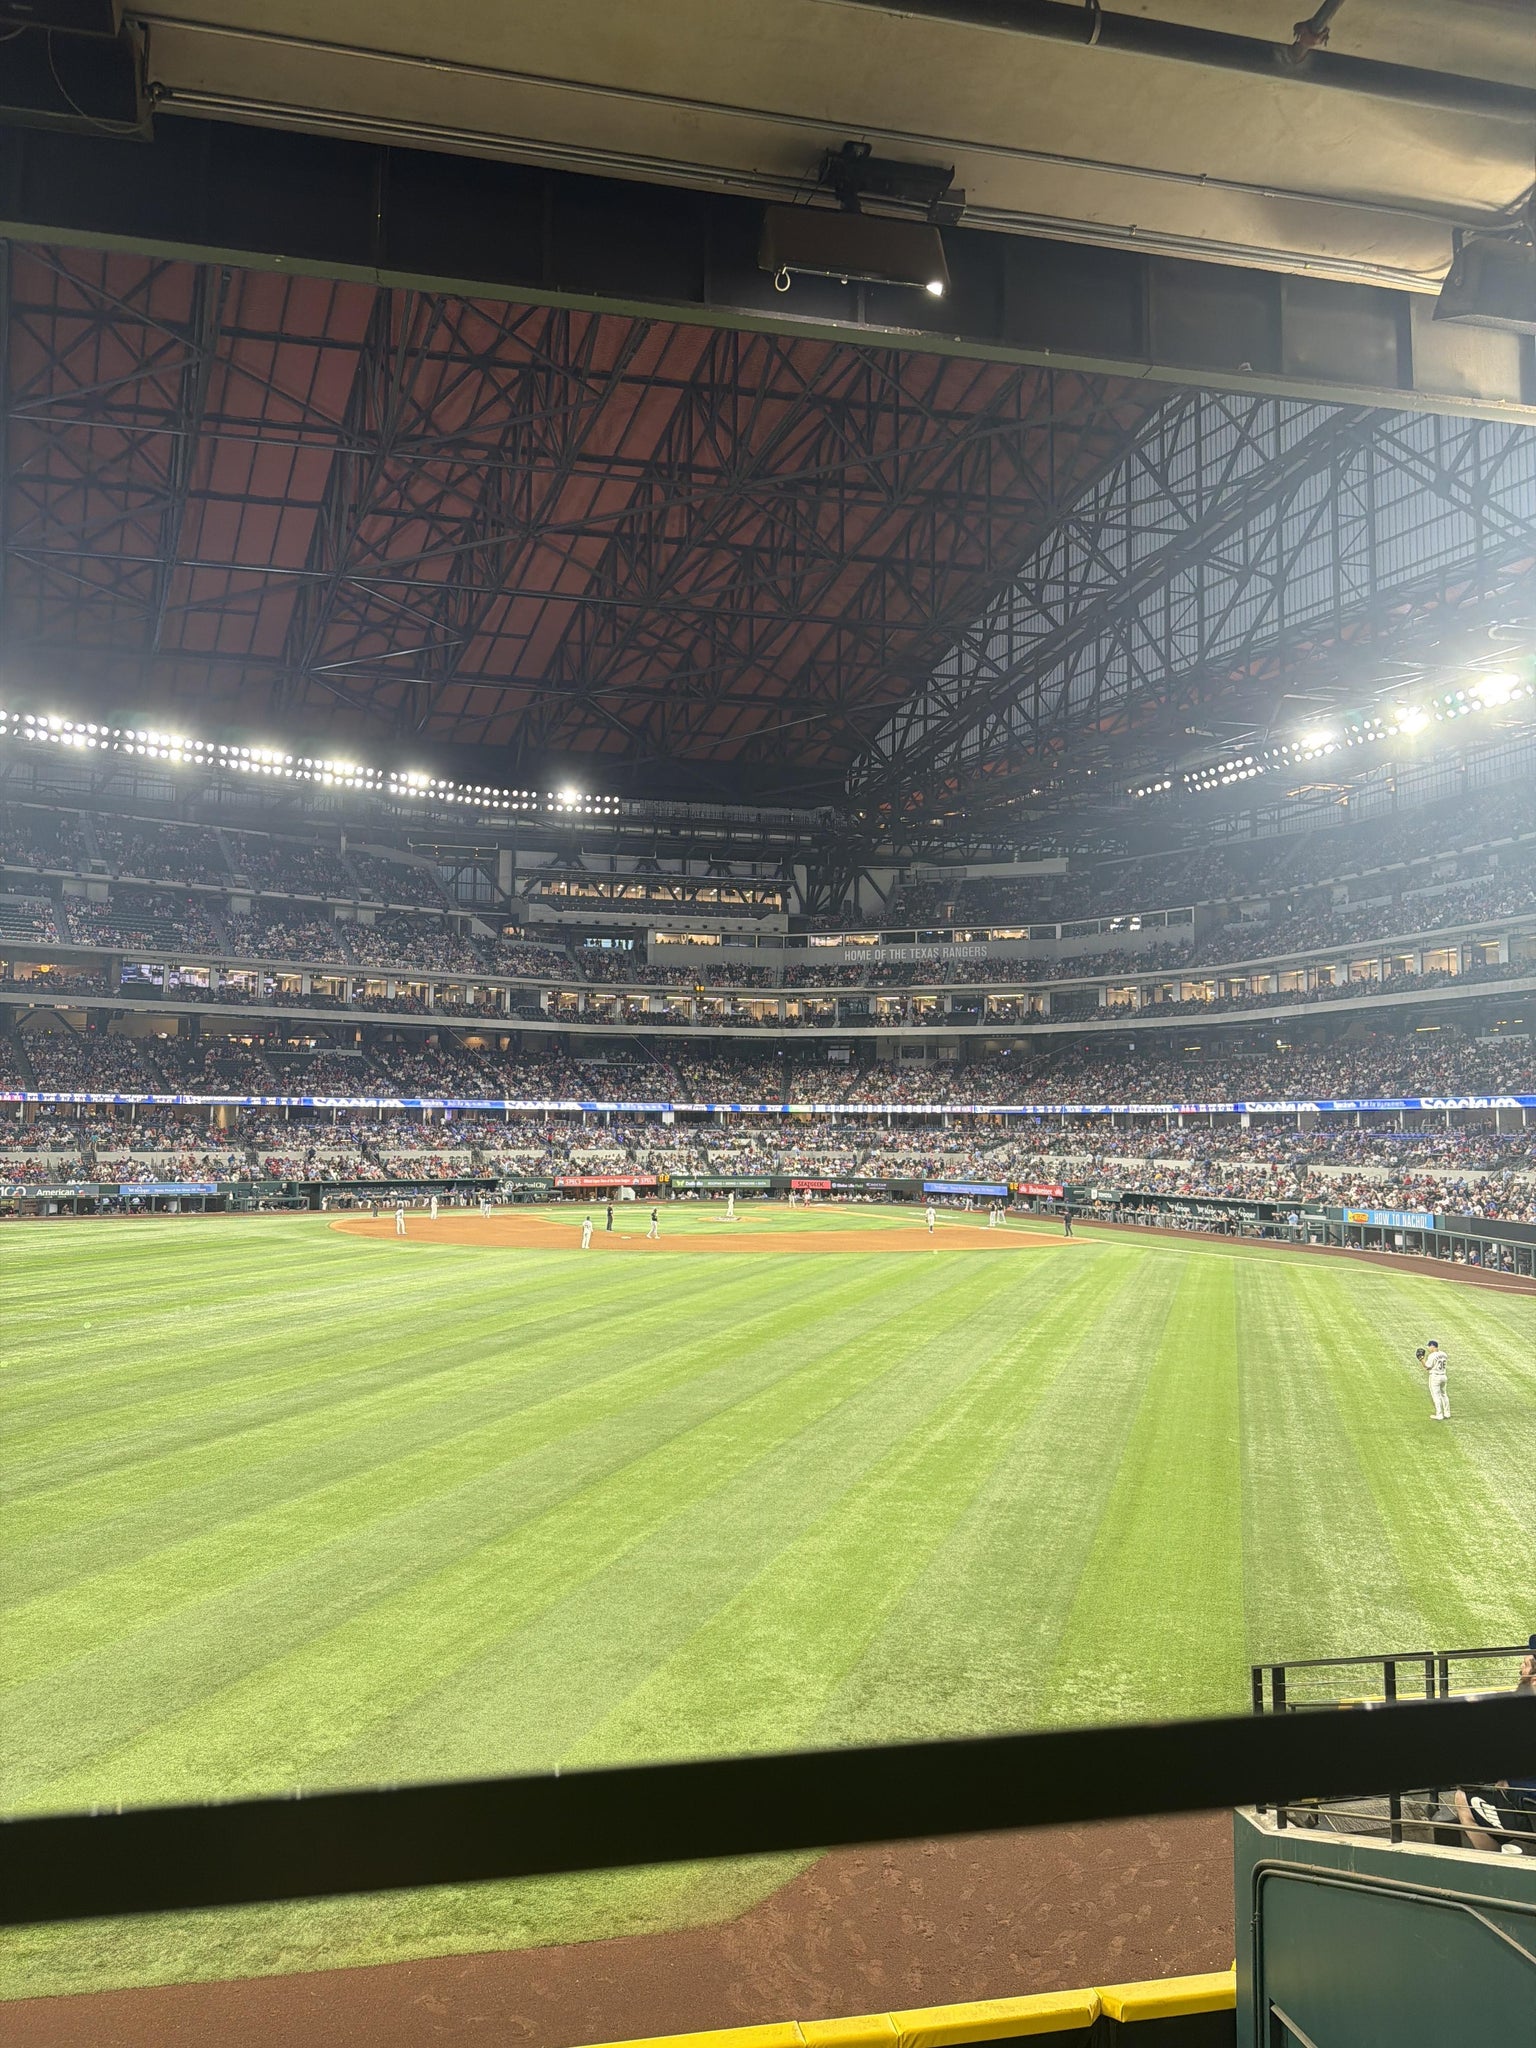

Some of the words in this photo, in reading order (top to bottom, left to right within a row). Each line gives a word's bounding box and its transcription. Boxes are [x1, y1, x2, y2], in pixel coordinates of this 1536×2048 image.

[844, 949, 871, 961] HOME
[874, 949, 886, 960] OF
[889, 948, 906, 960] THE
[910, 947, 939, 959] TEXAS
[943, 946, 987, 958] RANGERS
[1028, 1185, 1053, 1195] Budweiser
[1374, 1212, 1390, 1225] HOW
[1392, 1213, 1400, 1226] TO
[1402, 1214, 1427, 1228] NACHO!
